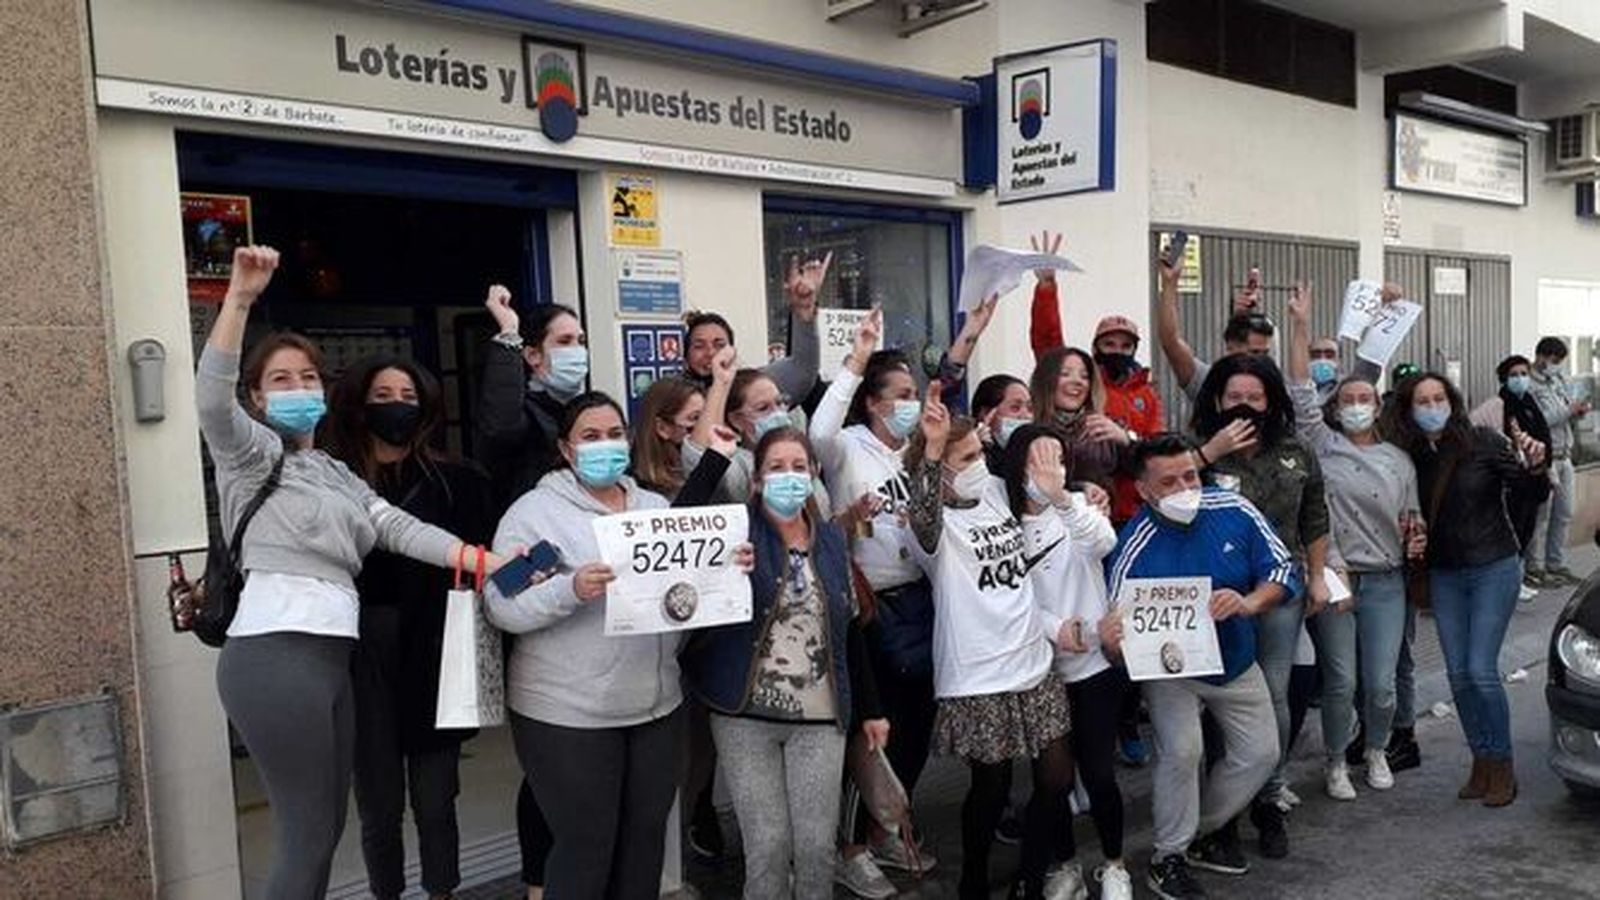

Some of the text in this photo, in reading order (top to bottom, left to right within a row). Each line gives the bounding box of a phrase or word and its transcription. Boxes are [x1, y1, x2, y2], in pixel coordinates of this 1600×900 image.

[336, 35, 851, 142] Loterías y Apuestas del Estado
[149, 91, 196, 109] Somos
[201, 97, 214, 111] la
[262, 104, 278, 118] de
[1054, 141, 1061, 156] y
[1011, 150, 1078, 176] Apuestas del
[1011, 174, 1046, 191] Estado
[651, 514, 727, 535] PREMIO
[632, 537, 726, 574] 52472
[1151, 586, 1198, 601] PREMIO
[1132, 605, 1197, 634] 52472
